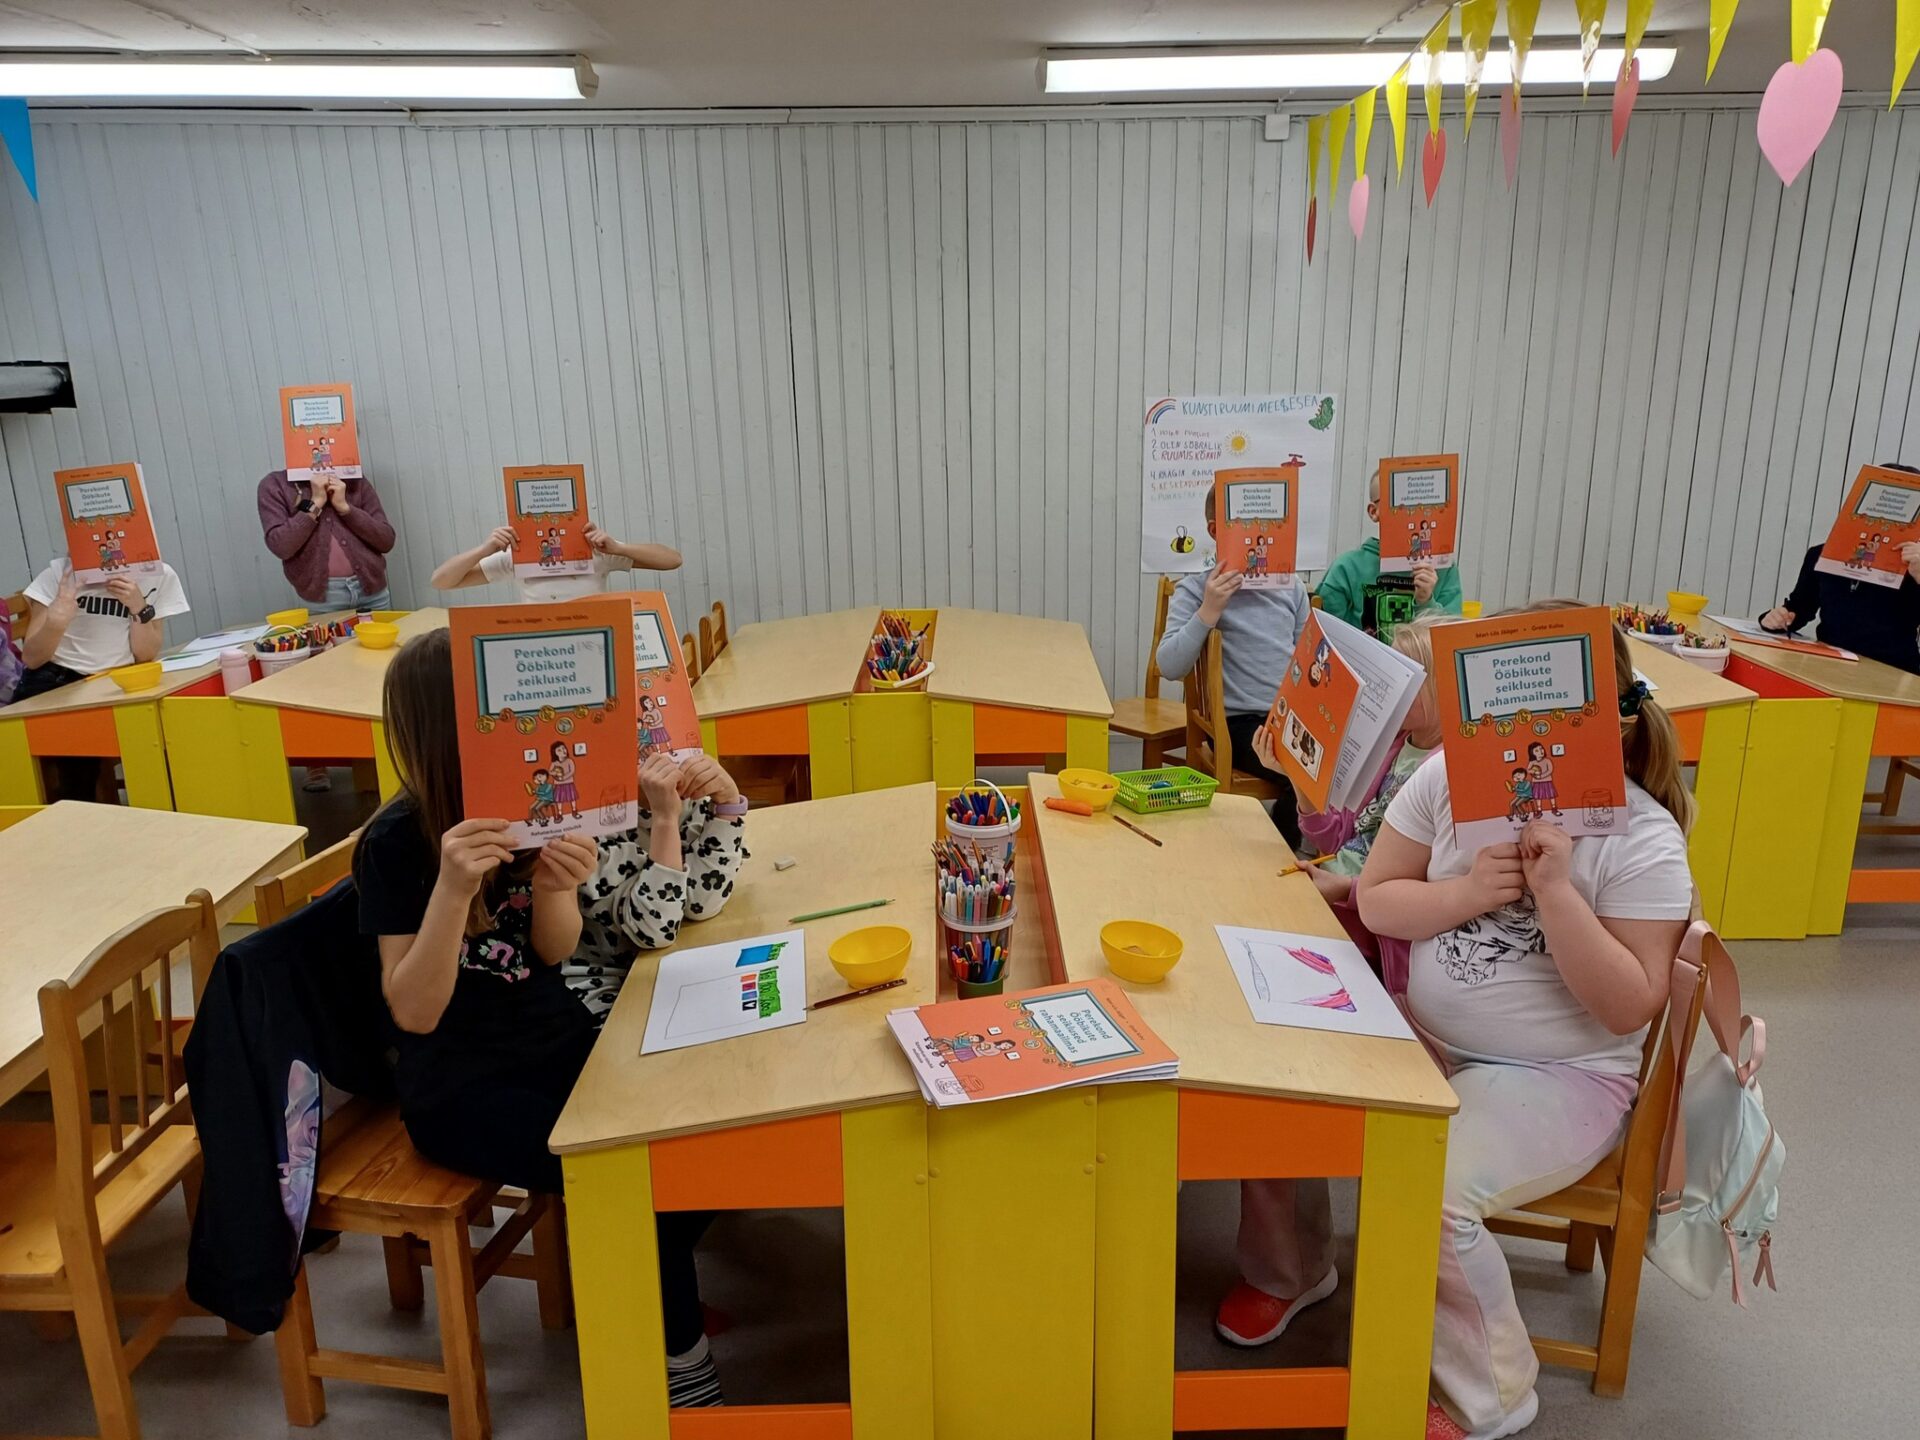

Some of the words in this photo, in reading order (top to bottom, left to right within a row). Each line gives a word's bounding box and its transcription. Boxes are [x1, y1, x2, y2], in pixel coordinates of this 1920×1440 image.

[514, 644, 575, 659] Perekond
[516, 660, 576, 672] Ööbikute
[1492, 652, 1551, 668] Perekond
[518, 672, 576, 687] seiklused
[1494, 667, 1552, 680] Ööbikute
[504, 686, 592, 702] rahamaailmas
[1496, 678, 1552, 694] seiklused
[1484, 691, 1569, 708] rahamaailmas
[1039, 1009, 1078, 1054] rahamaailmas
[1057, 1014, 1087, 1044] seiklused
[1070, 1011, 1097, 1041] Ööbikute
[1081, 1009, 1112, 1040] Perekond
